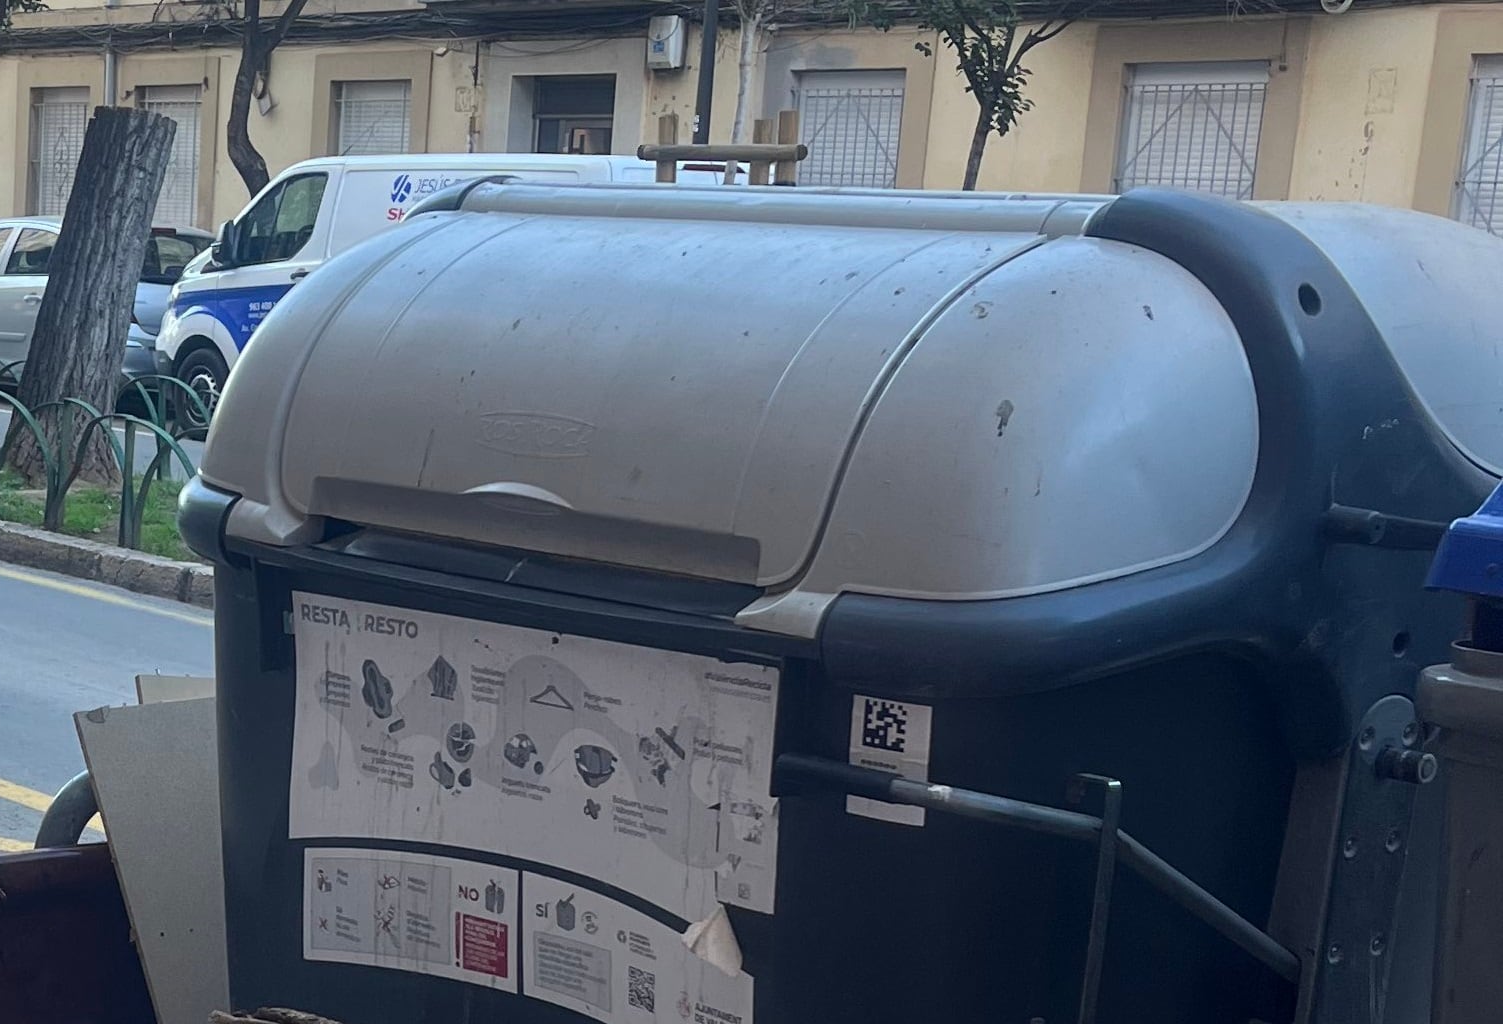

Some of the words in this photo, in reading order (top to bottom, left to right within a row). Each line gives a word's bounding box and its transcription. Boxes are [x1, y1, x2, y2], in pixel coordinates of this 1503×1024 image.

[301, 603, 350, 628] RESTA
[365, 613, 419, 639] RESTO
[458, 884, 480, 902] NO
